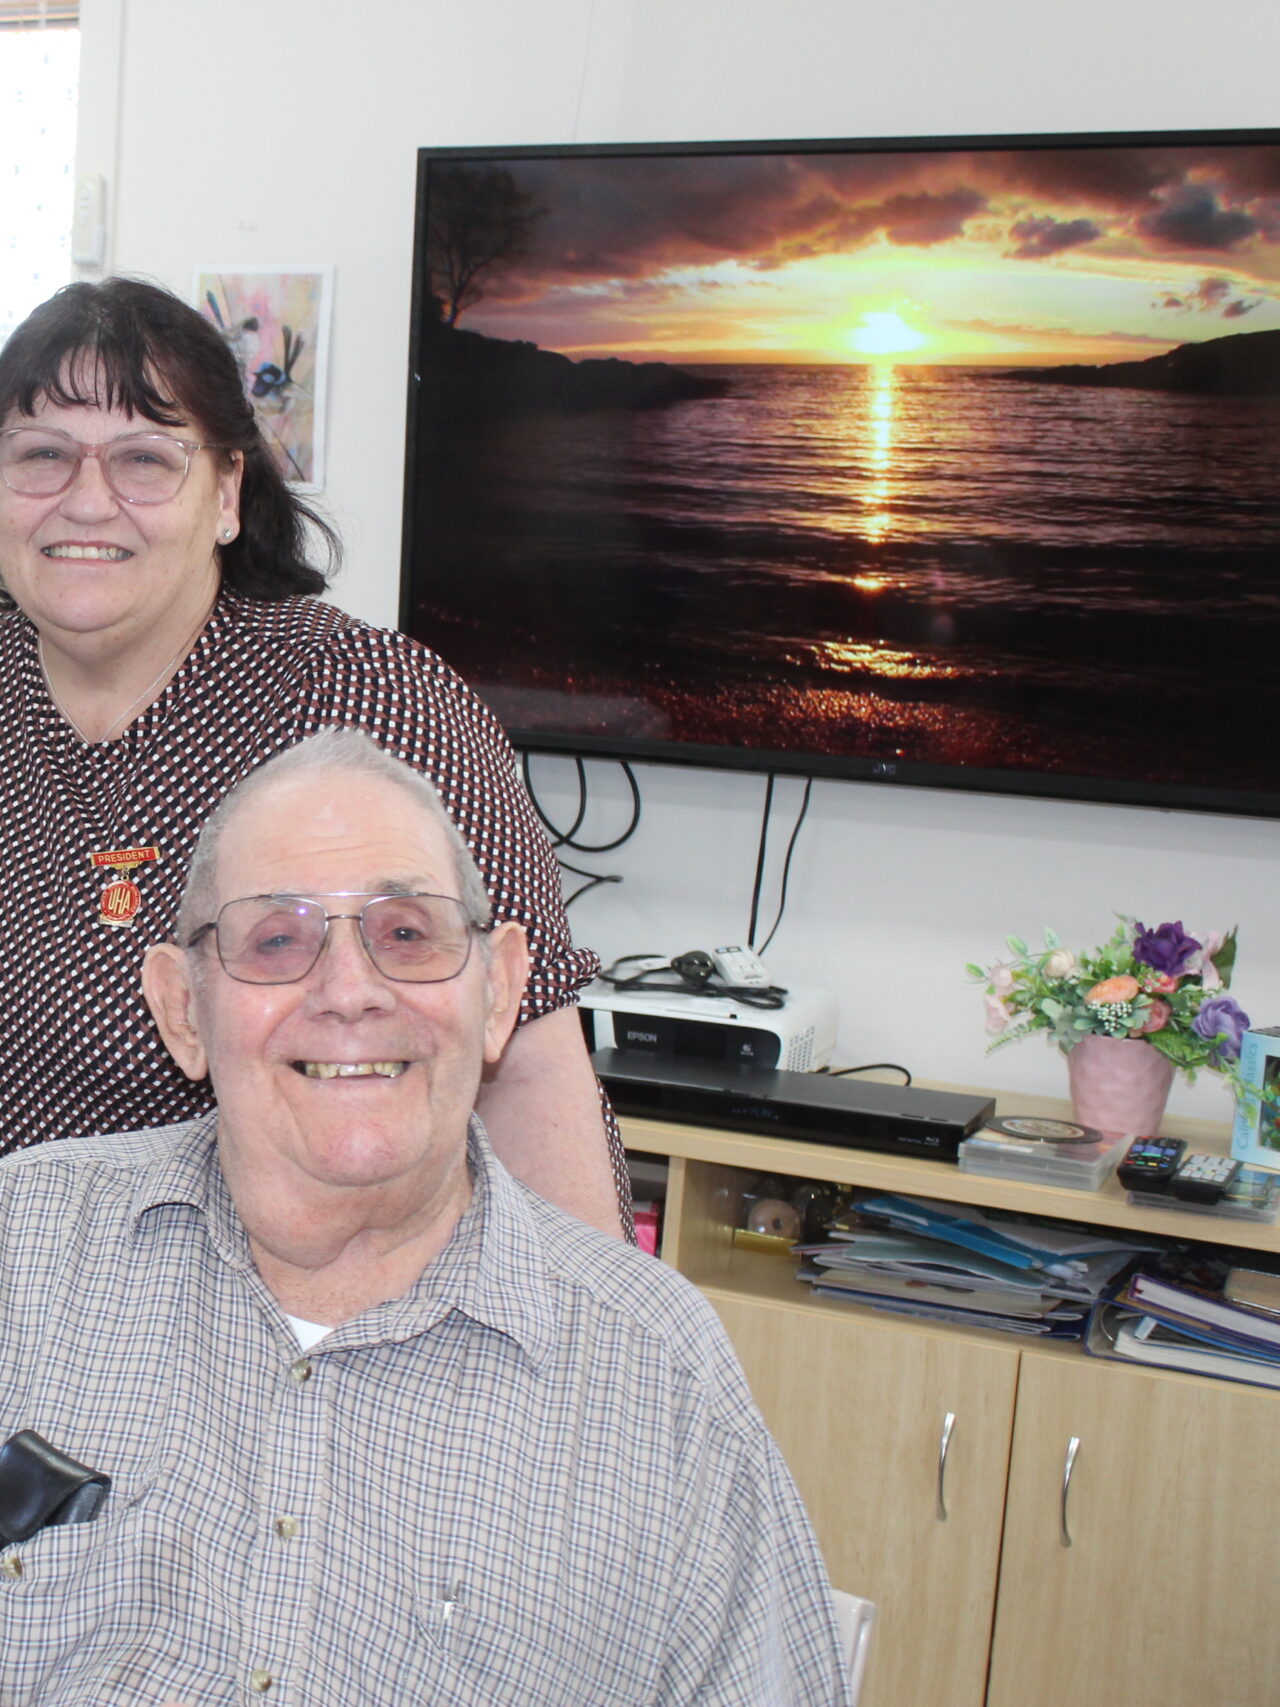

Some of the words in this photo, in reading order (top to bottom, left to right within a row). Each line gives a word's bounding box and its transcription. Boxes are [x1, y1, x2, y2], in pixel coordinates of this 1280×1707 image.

[97, 849, 150, 863] PRESIDENT
[108, 887, 131, 915] UHA
[627, 1031, 657, 1043] EPSON
[1244, 1042, 1258, 1090] lassics
